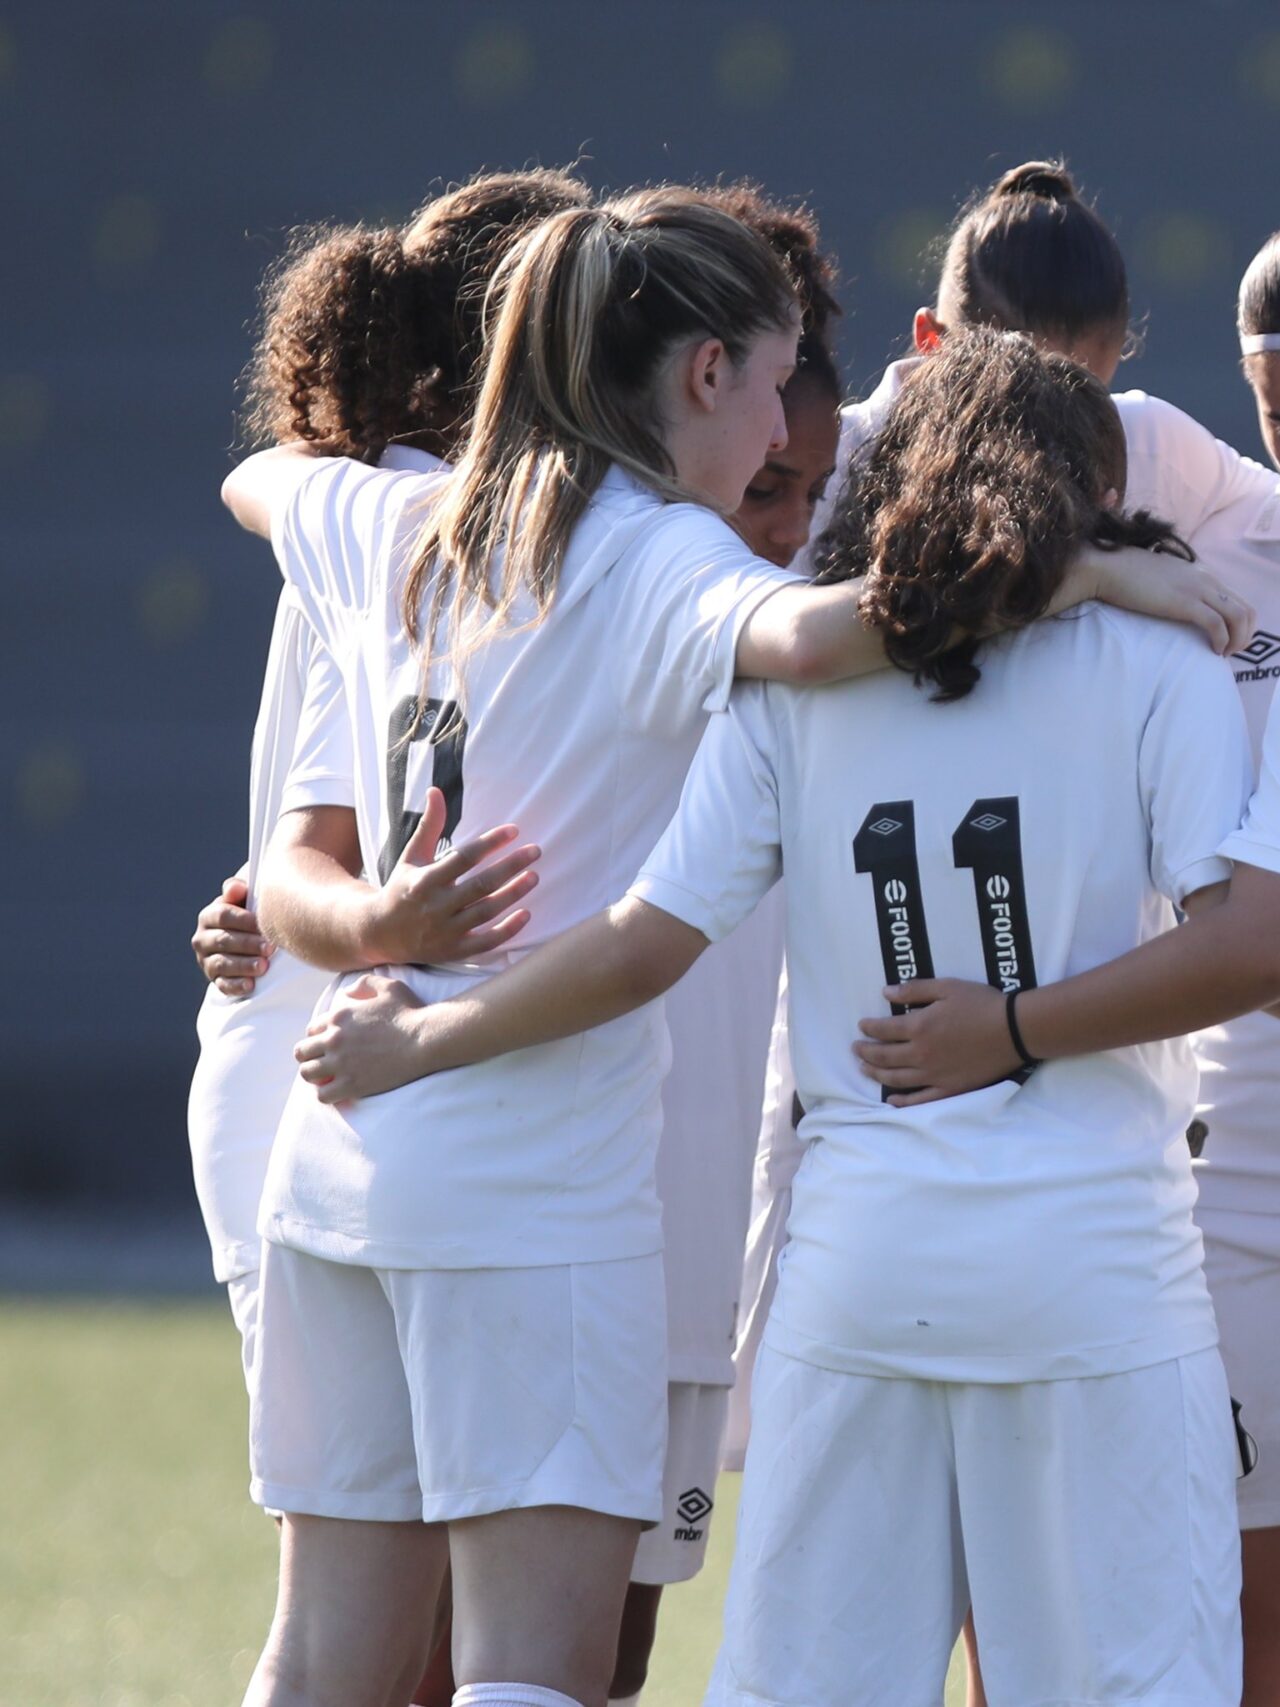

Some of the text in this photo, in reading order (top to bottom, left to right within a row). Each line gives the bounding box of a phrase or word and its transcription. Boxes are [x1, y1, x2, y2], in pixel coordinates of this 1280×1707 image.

[853, 796, 1040, 1103] 11
[884, 879, 917, 984] eFOOTB
[987, 875, 1021, 994] eFOOTBA
